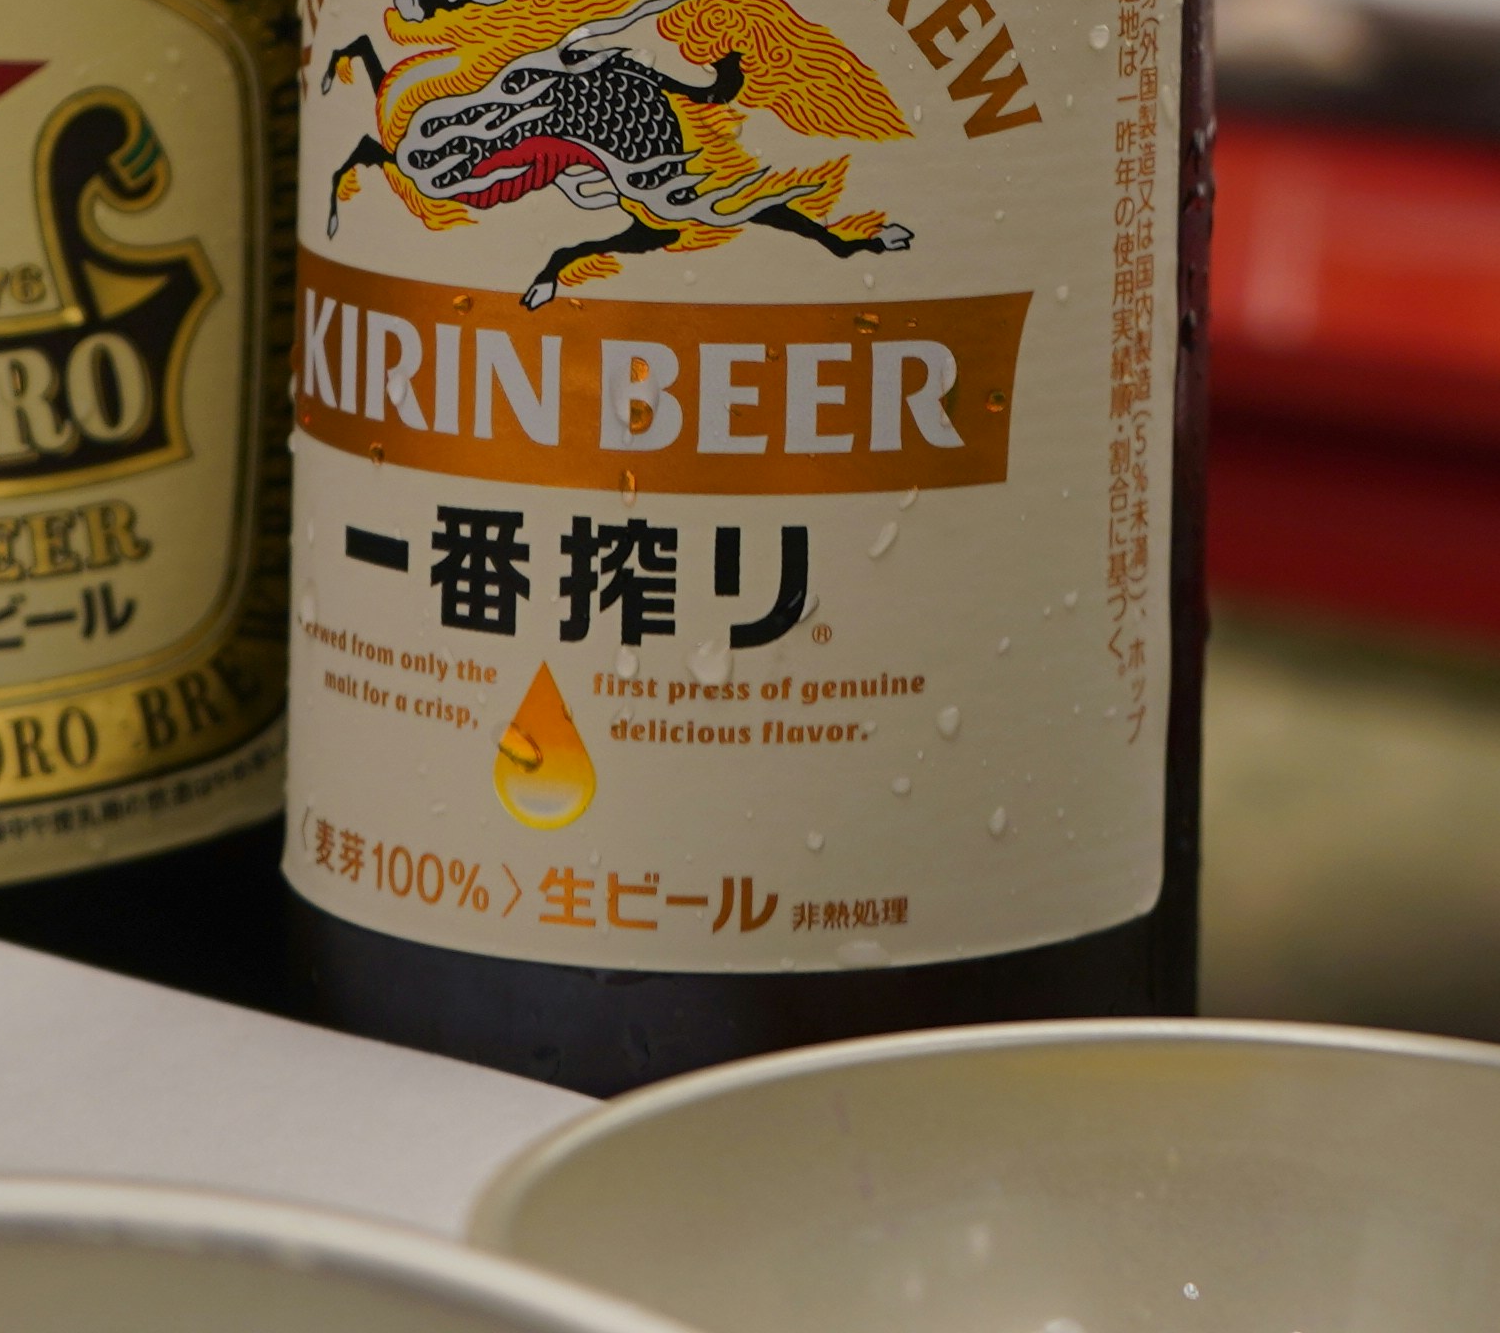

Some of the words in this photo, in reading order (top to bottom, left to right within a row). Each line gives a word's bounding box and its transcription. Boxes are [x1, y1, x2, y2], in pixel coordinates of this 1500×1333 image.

[303, 288, 560, 447] KIRIN
[598, 339, 966, 455] BEER
[344, 505, 810, 650] 一番搾り
[323, 669, 358, 700] malt
[362, 680, 390, 708] for
[395, 695, 408, 713] a
[413, 697, 479, 731] crisp,
[610, 719, 752, 745] delicious
[761, 720, 869, 745] flavor.
[352, 633, 394, 666] from
[400, 650, 449, 681] only
[457, 658, 498, 685] the
[592, 673, 658, 699] first
[668, 681, 750, 706] press
[760, 676, 793, 701] of
[801, 672, 926, 706] genuine
